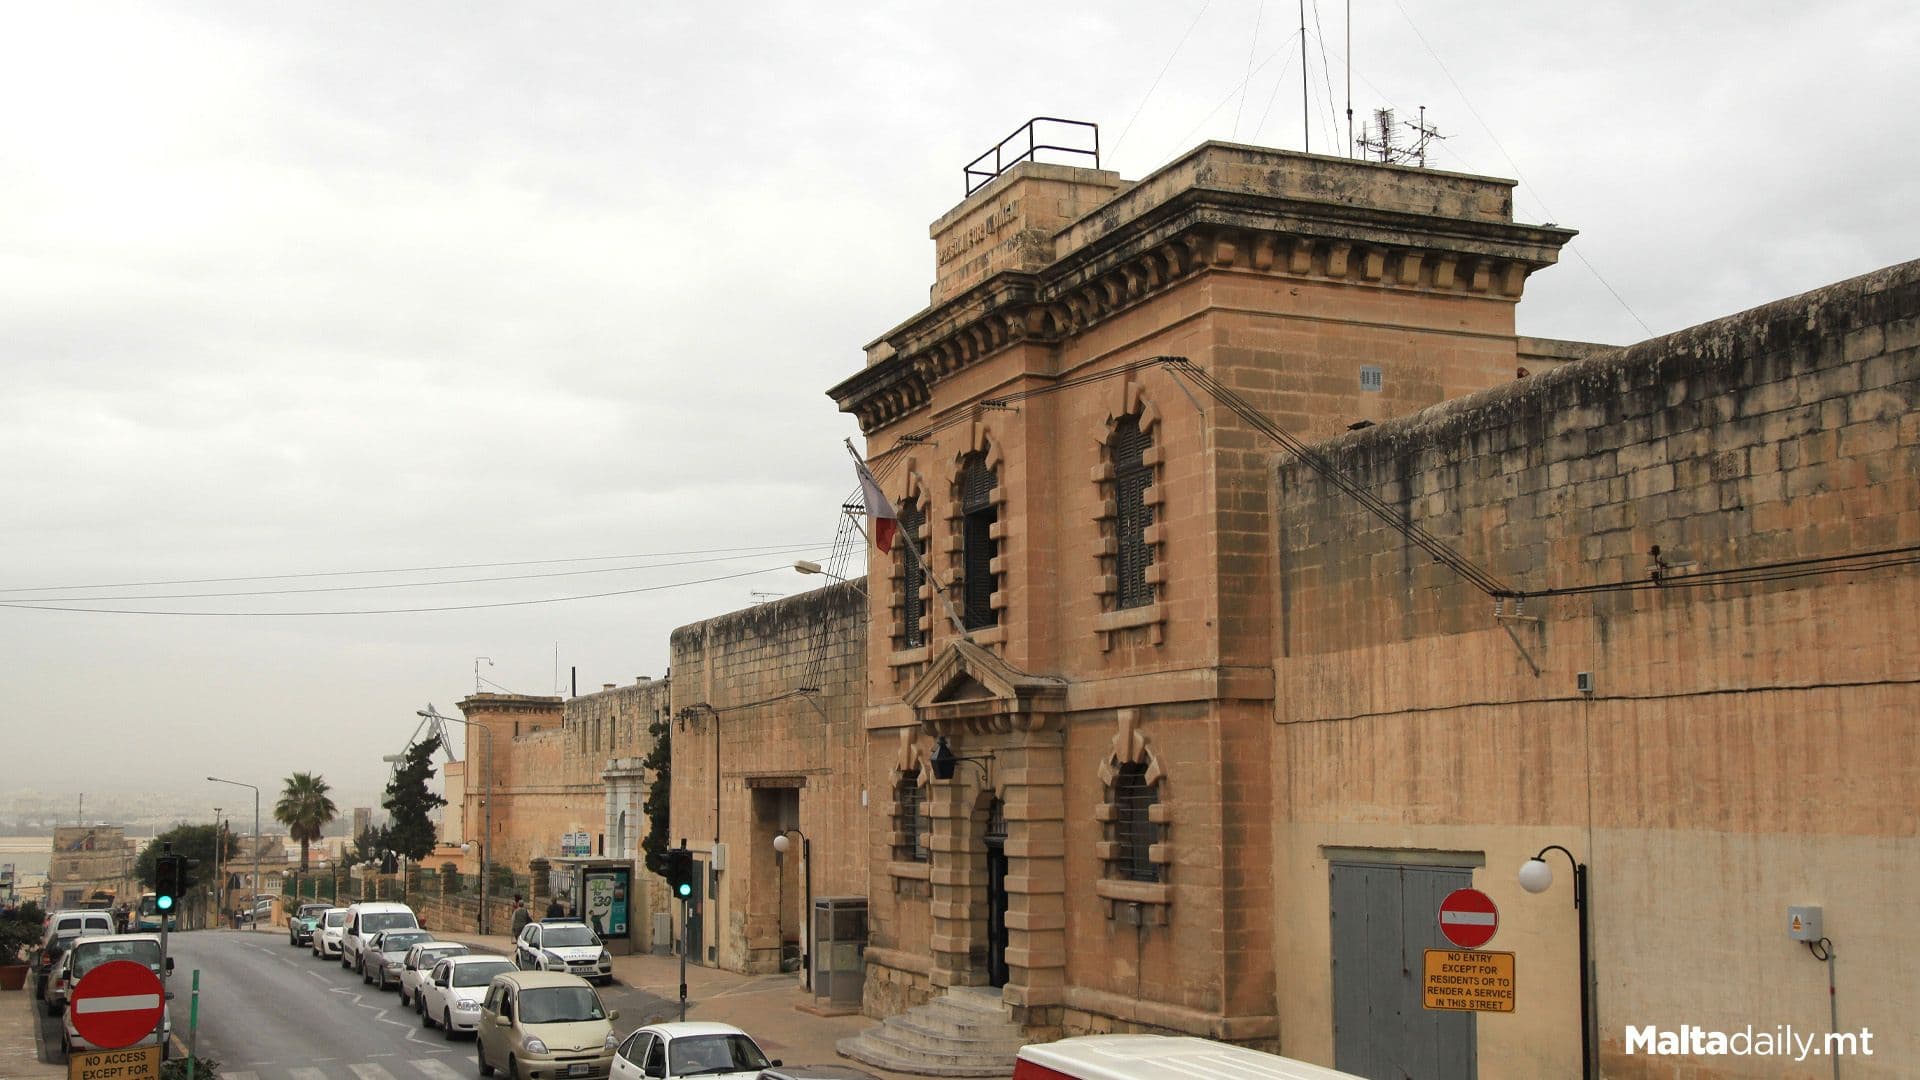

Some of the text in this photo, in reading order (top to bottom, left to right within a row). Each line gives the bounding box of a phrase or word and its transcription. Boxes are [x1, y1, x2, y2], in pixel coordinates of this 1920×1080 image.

[1447, 953, 1493, 963] NO ENTRY
[1442, 964, 1498, 975] EXCEPT FOR
[1430, 975, 1510, 987] RESIDENTS OR TO
[1427, 986, 1513, 999] RENDER A SERVICE
[1435, 998, 1504, 1010] IN THIS STREET
[85, 1052, 146, 1067] NO ACCESS
[82, 1064, 149, 1080] EXCEPT FOR
